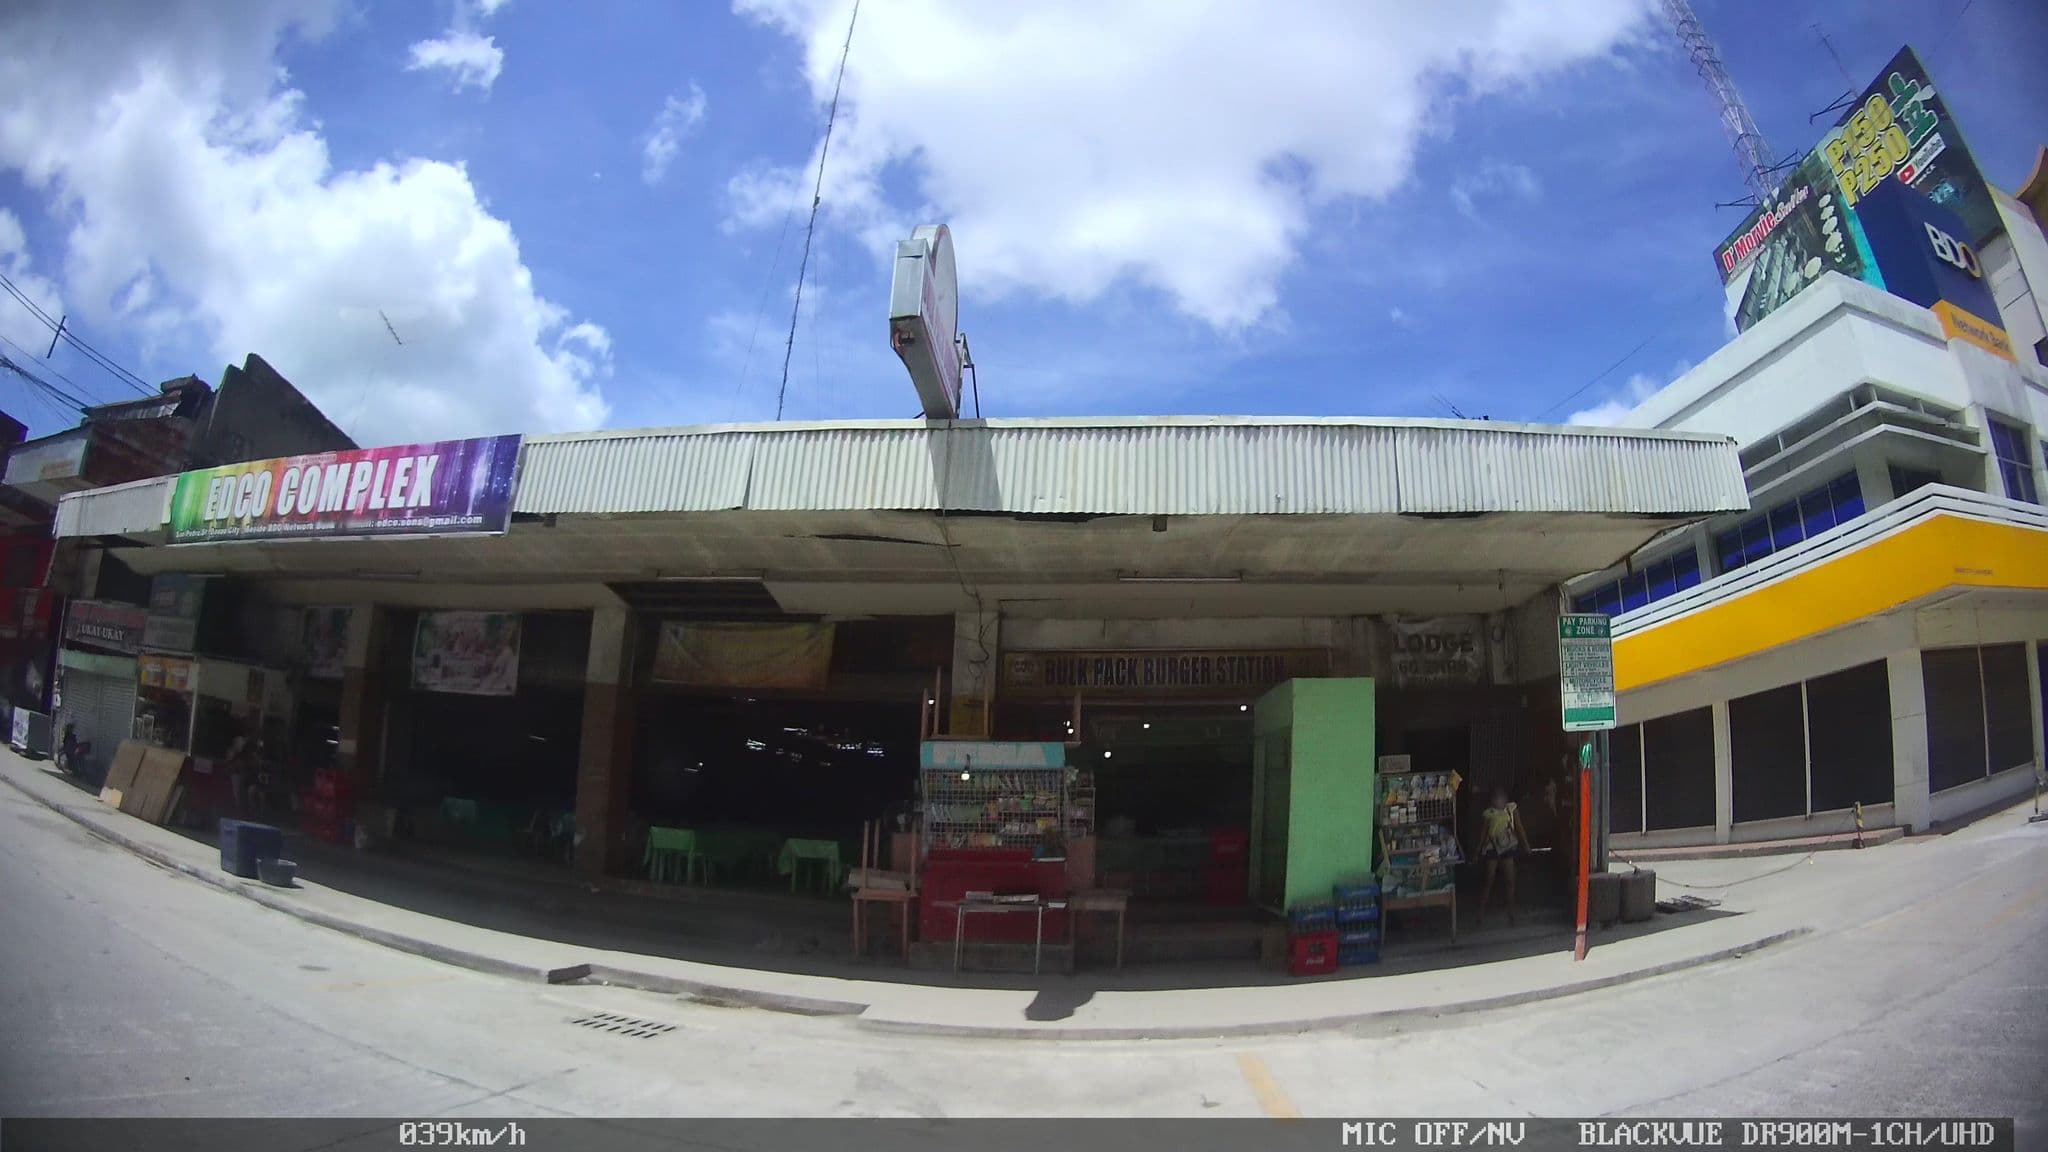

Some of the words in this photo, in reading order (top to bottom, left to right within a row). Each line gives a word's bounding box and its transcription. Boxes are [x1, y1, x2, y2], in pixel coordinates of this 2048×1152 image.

[1824, 93, 1893, 178] P150
[1839, 123, 1910, 209] P250
[1913, 137, 1943, 169] YouTube
[1924, 221, 1983, 278] BDO
[204, 469, 273, 521] EDCO
[277, 455, 439, 516] COMPLEX
[1562, 617, 1576, 626] PAY
[1579, 617, 1607, 626] PARKING
[1576, 626, 1594, 635] ZONE
[1392, 632, 1473, 653] LODGE
[1046, 657, 1087, 686] BULK
[1093, 656, 1138, 686] PACK
[1143, 655, 1210, 685] BURGER
[1216, 655, 1288, 685] STATION
